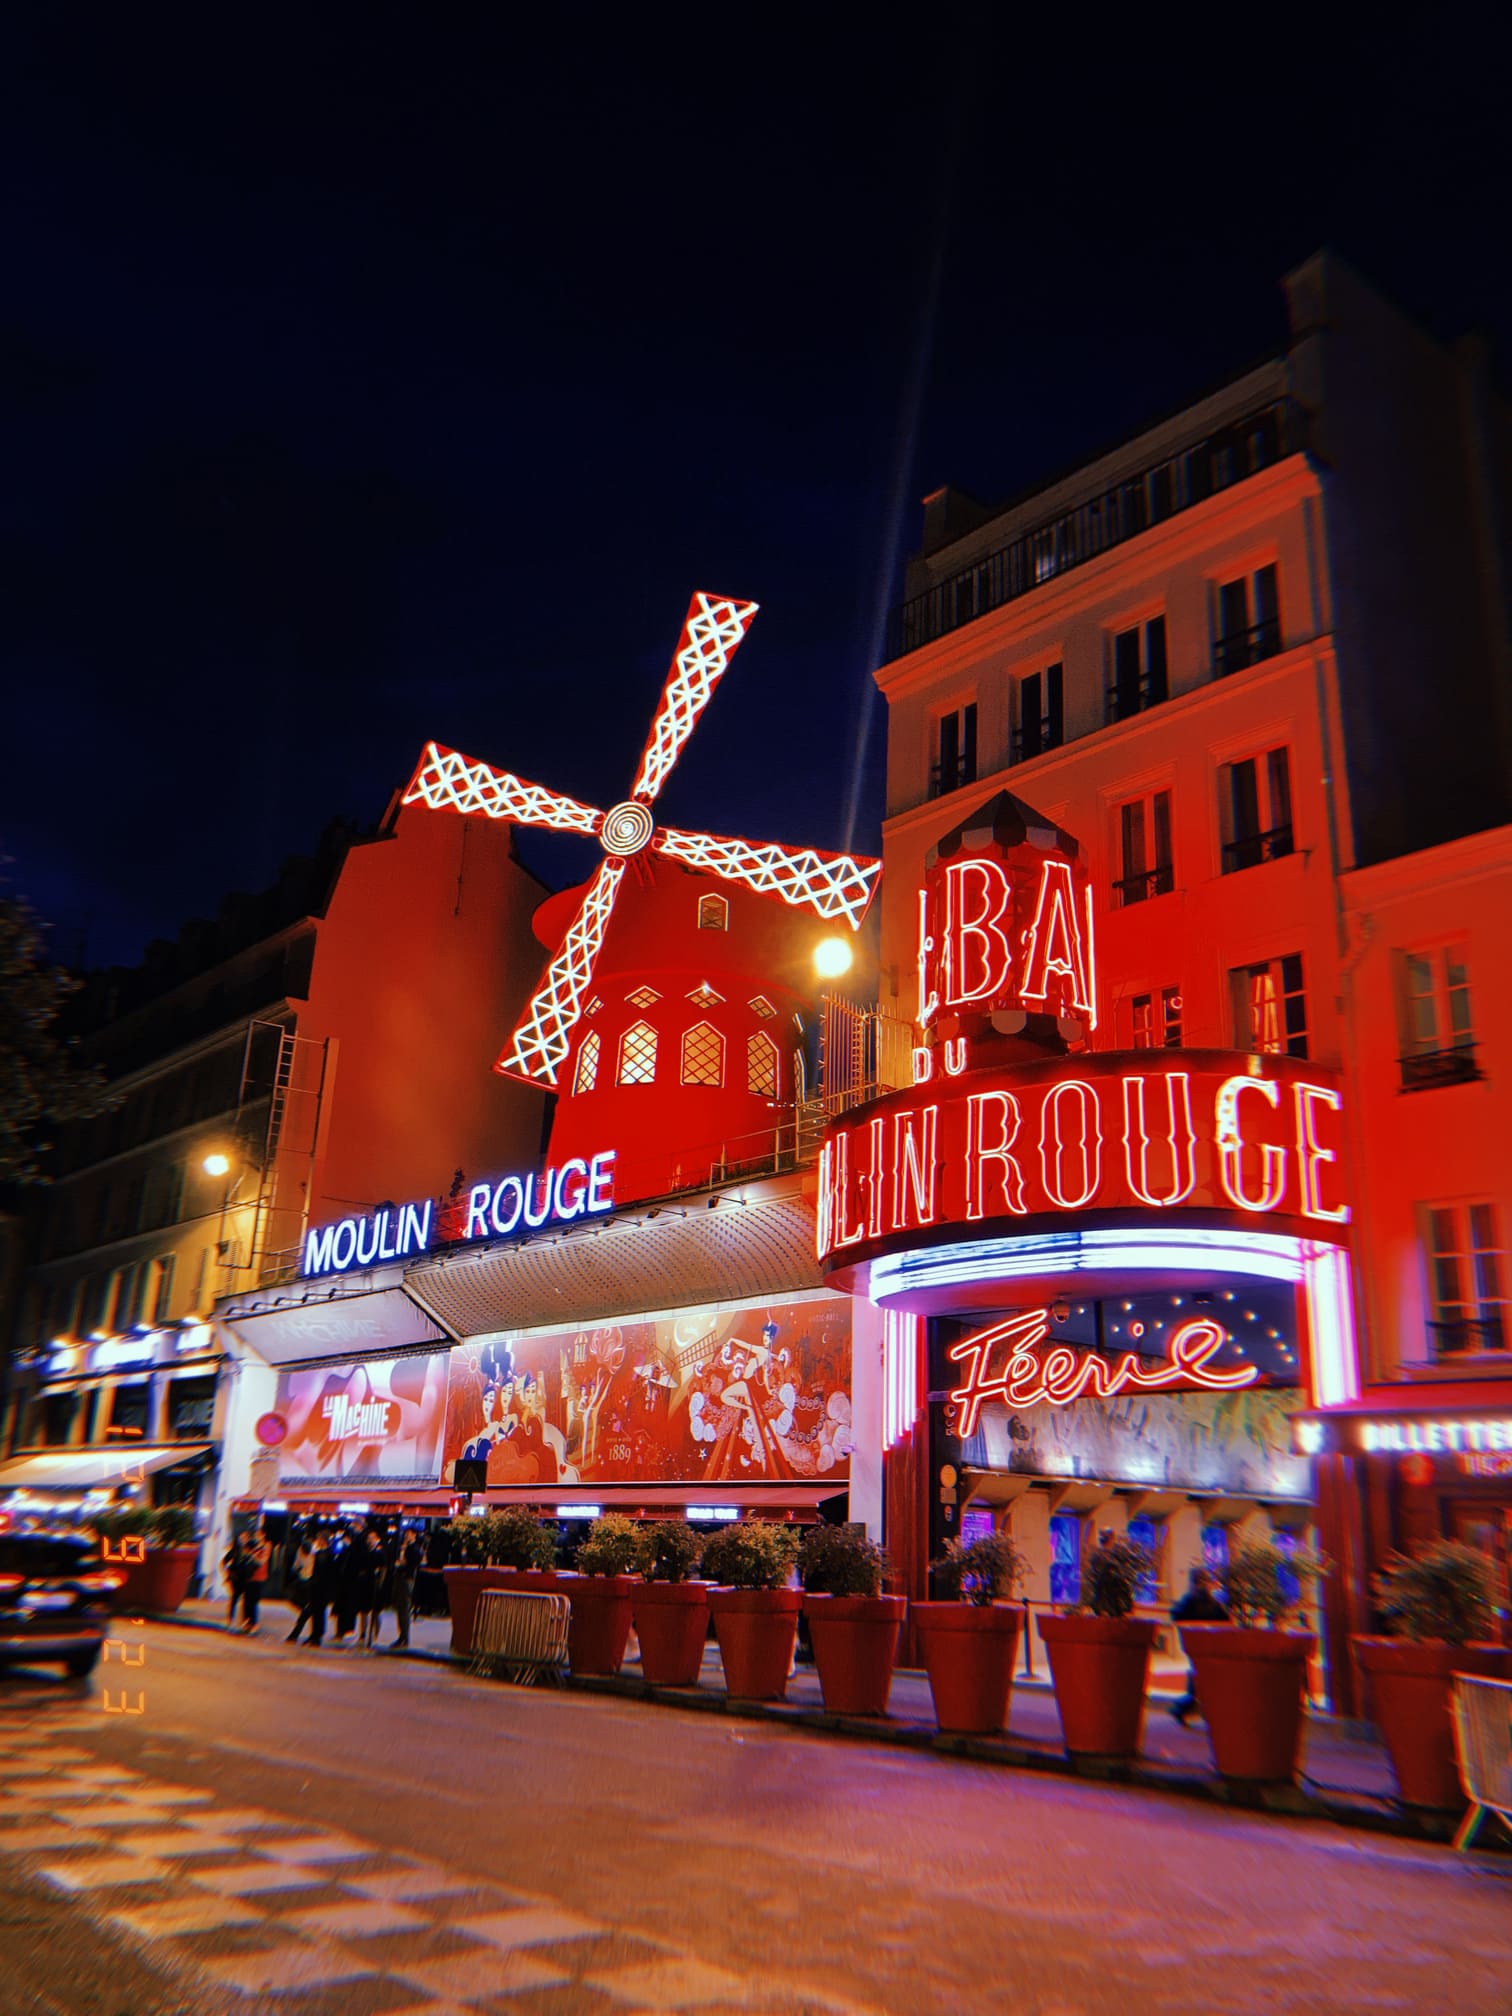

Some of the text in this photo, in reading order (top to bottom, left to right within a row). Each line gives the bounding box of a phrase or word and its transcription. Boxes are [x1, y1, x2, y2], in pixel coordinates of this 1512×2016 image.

[912, 1036, 967, 1085] DU
[965, 1072, 1352, 1223] ROUGE
[304, 1149, 616, 1275] MOULIN ROUGE
[608, 1443, 632, 1465] 1889
